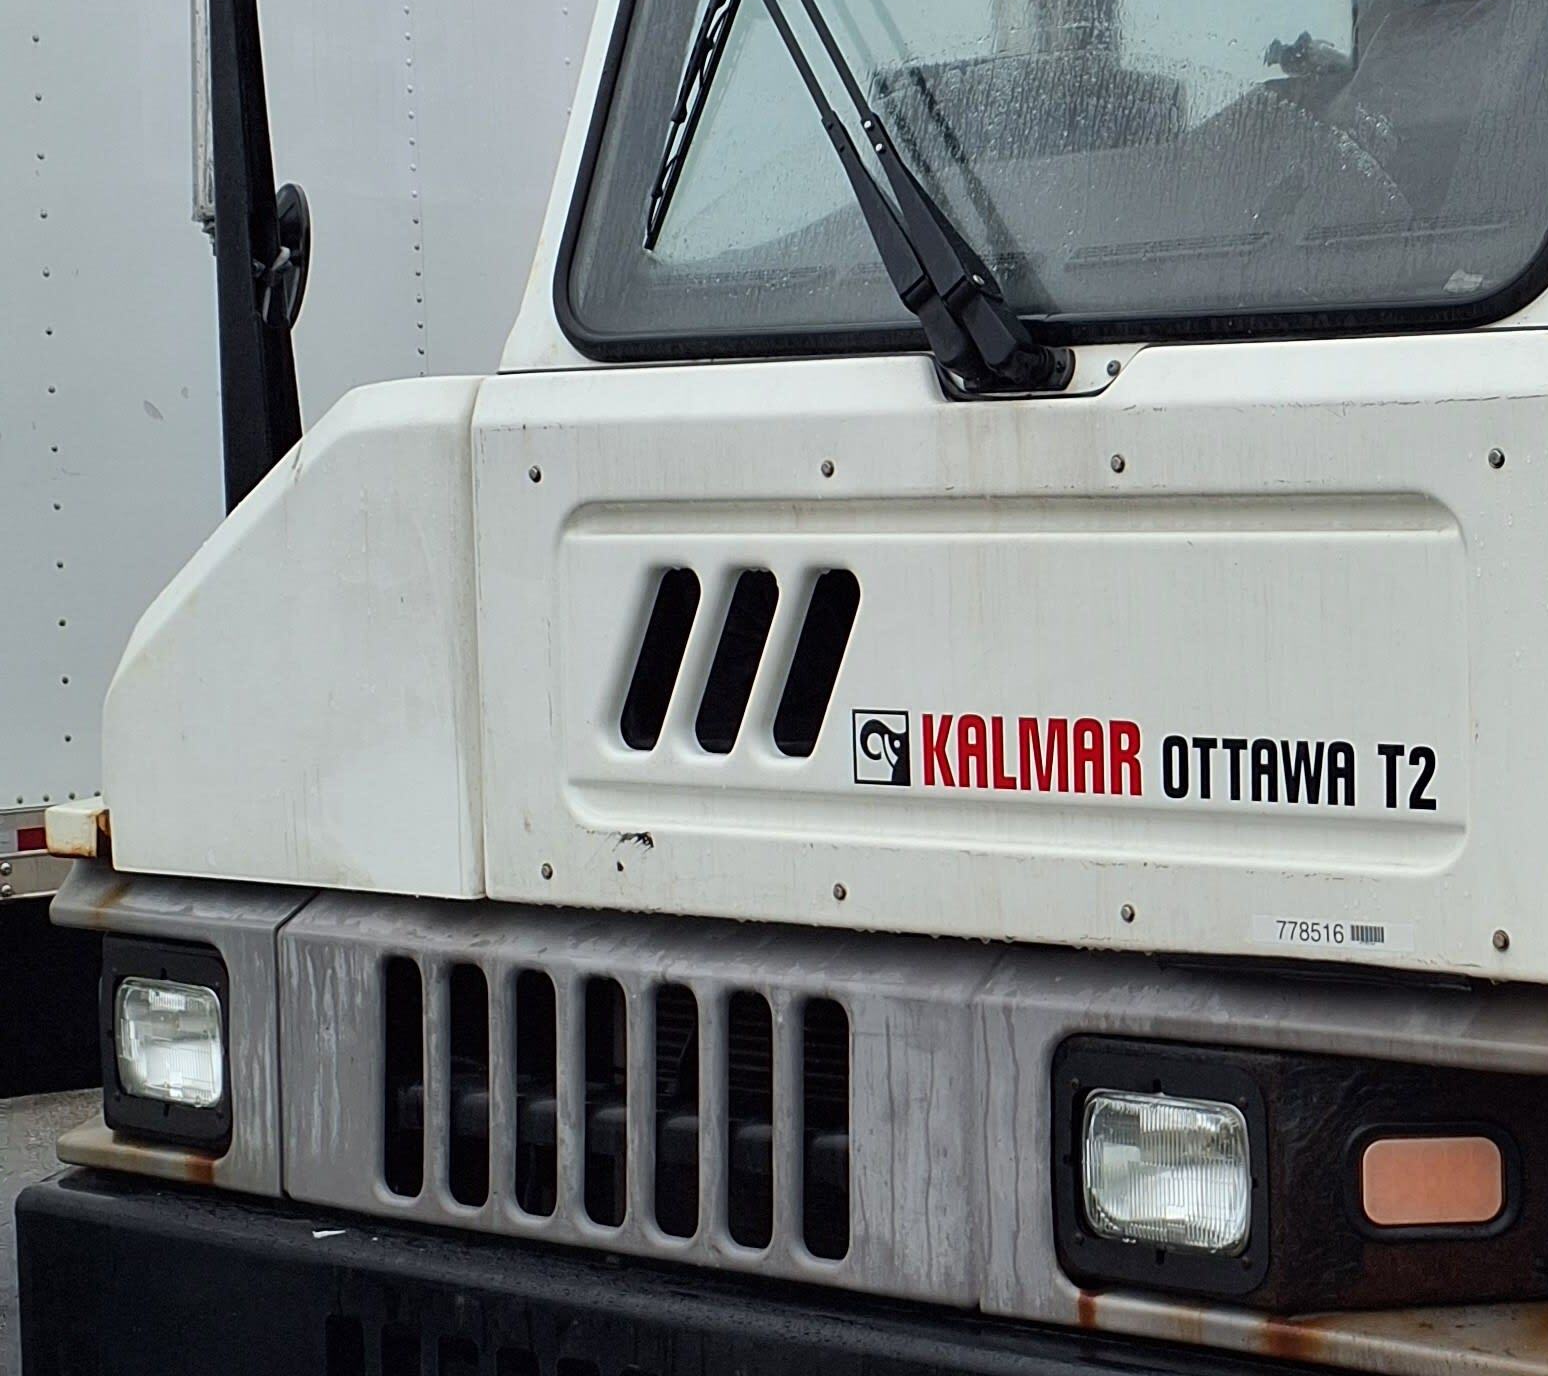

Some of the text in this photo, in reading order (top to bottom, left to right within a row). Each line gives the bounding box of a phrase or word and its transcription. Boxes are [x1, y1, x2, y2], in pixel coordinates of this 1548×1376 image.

[921, 713, 1438, 811] KALMAR OTTAWA T2
[1275, 920, 1345, 944] 778516
